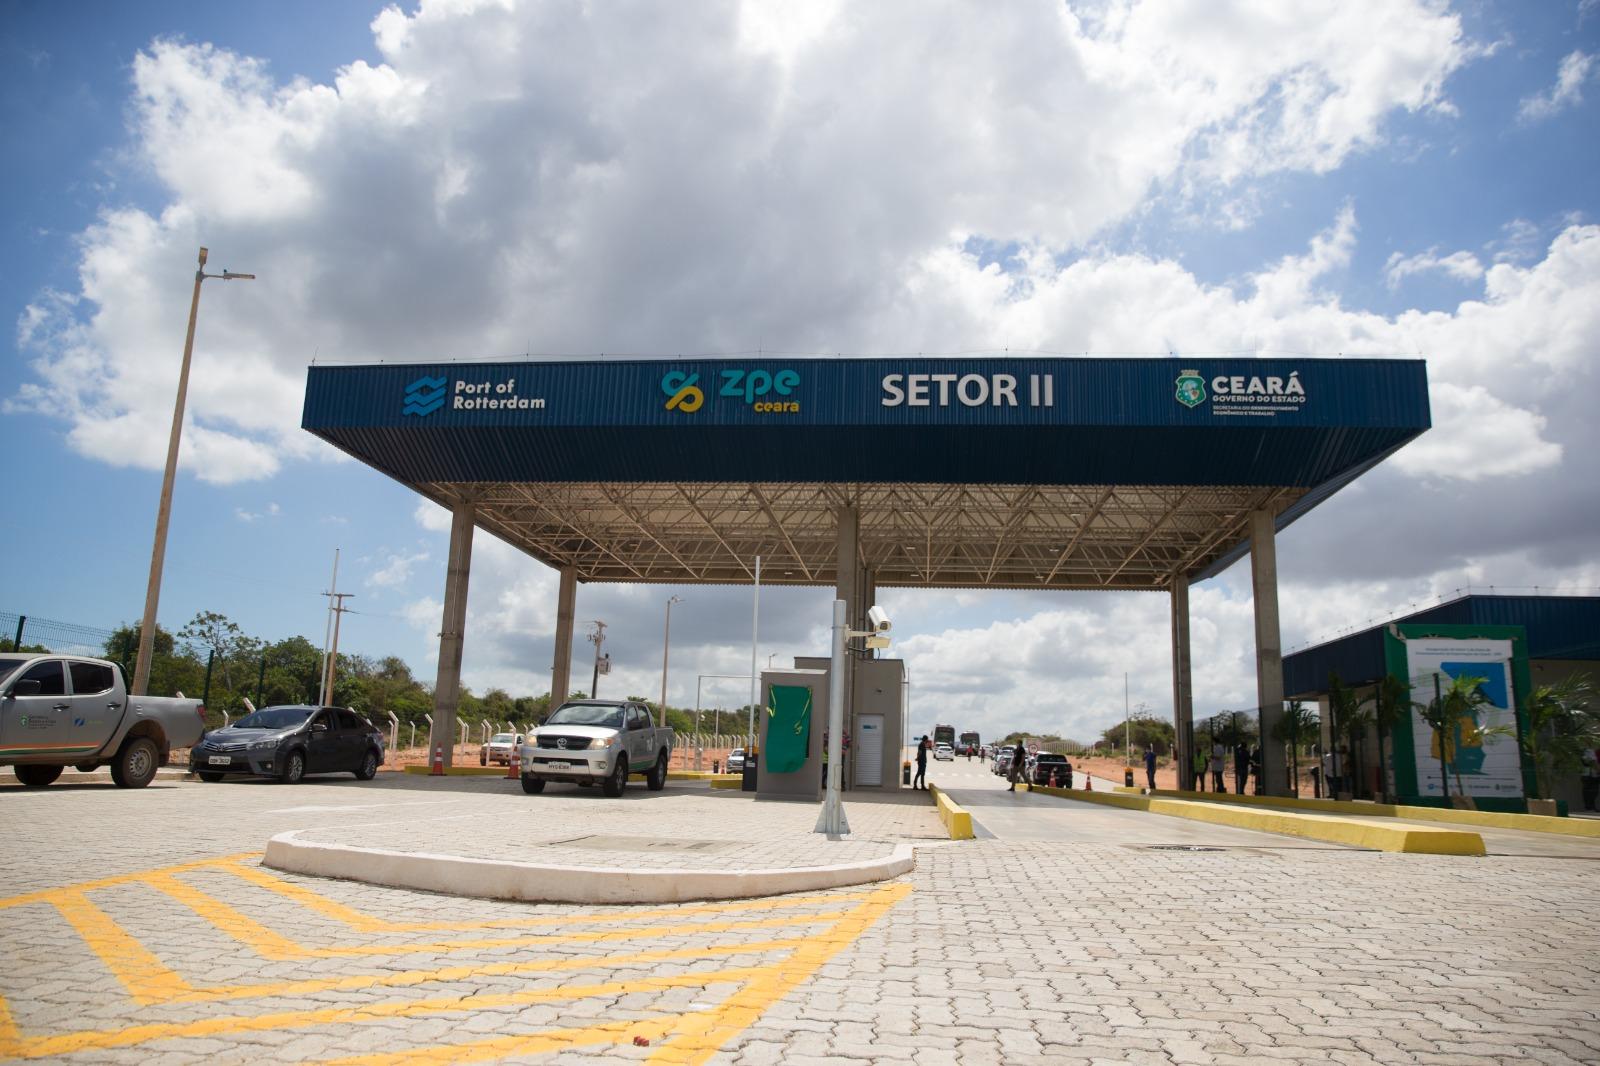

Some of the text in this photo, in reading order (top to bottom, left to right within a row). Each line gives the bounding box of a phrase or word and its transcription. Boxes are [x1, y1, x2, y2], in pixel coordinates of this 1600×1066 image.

[455, 379, 515, 394] Port of
[720, 369, 800, 404] zpe
[881, 374, 1053, 407] SETOR II
[1211, 370, 1305, 395] CEARÁ
[453, 395, 545, 409] Rotterdam
[1212, 395, 1306, 403] GOVERNO DO ESTADO
